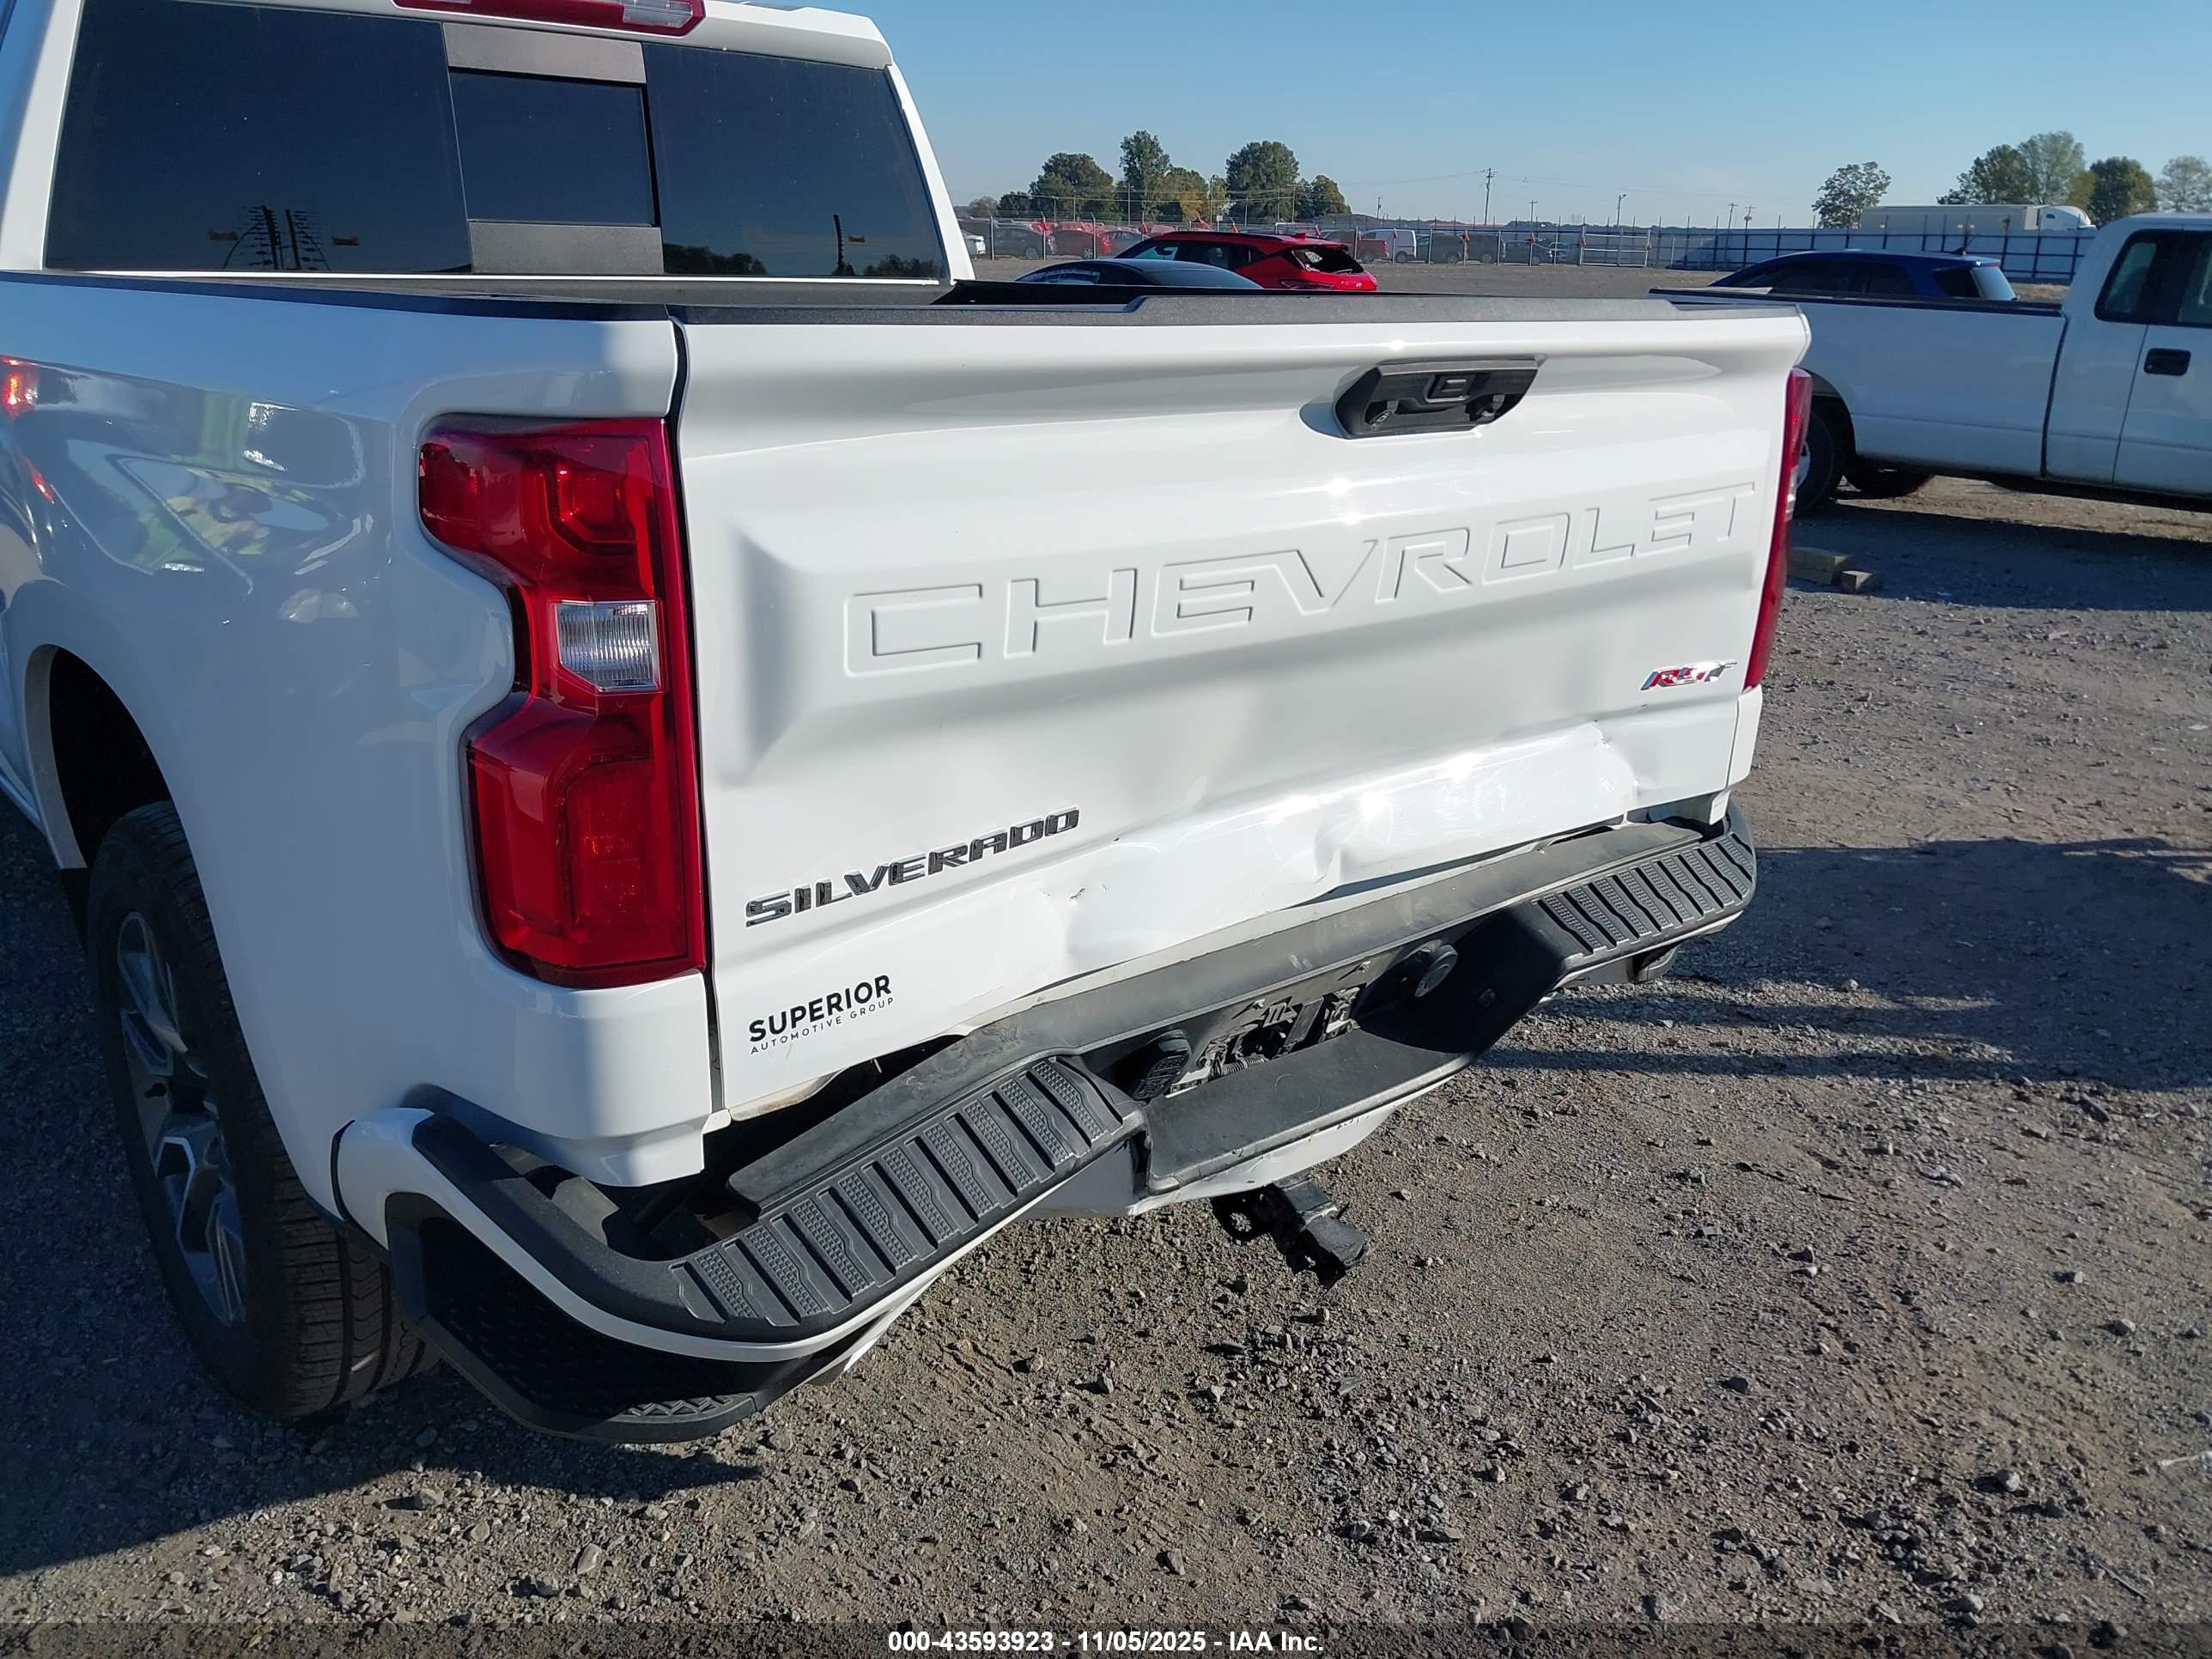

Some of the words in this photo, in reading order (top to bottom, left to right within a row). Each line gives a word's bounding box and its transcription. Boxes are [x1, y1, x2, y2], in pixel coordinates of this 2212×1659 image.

[842, 482, 1755, 679] CHEVROLET
[745, 805, 1080, 927] SILVERADO
[748, 974, 892, 1042] SUPERIOR
[750, 1015, 842, 1055] AUTOMOTIVE
[849, 996, 895, 1019] GROUP
